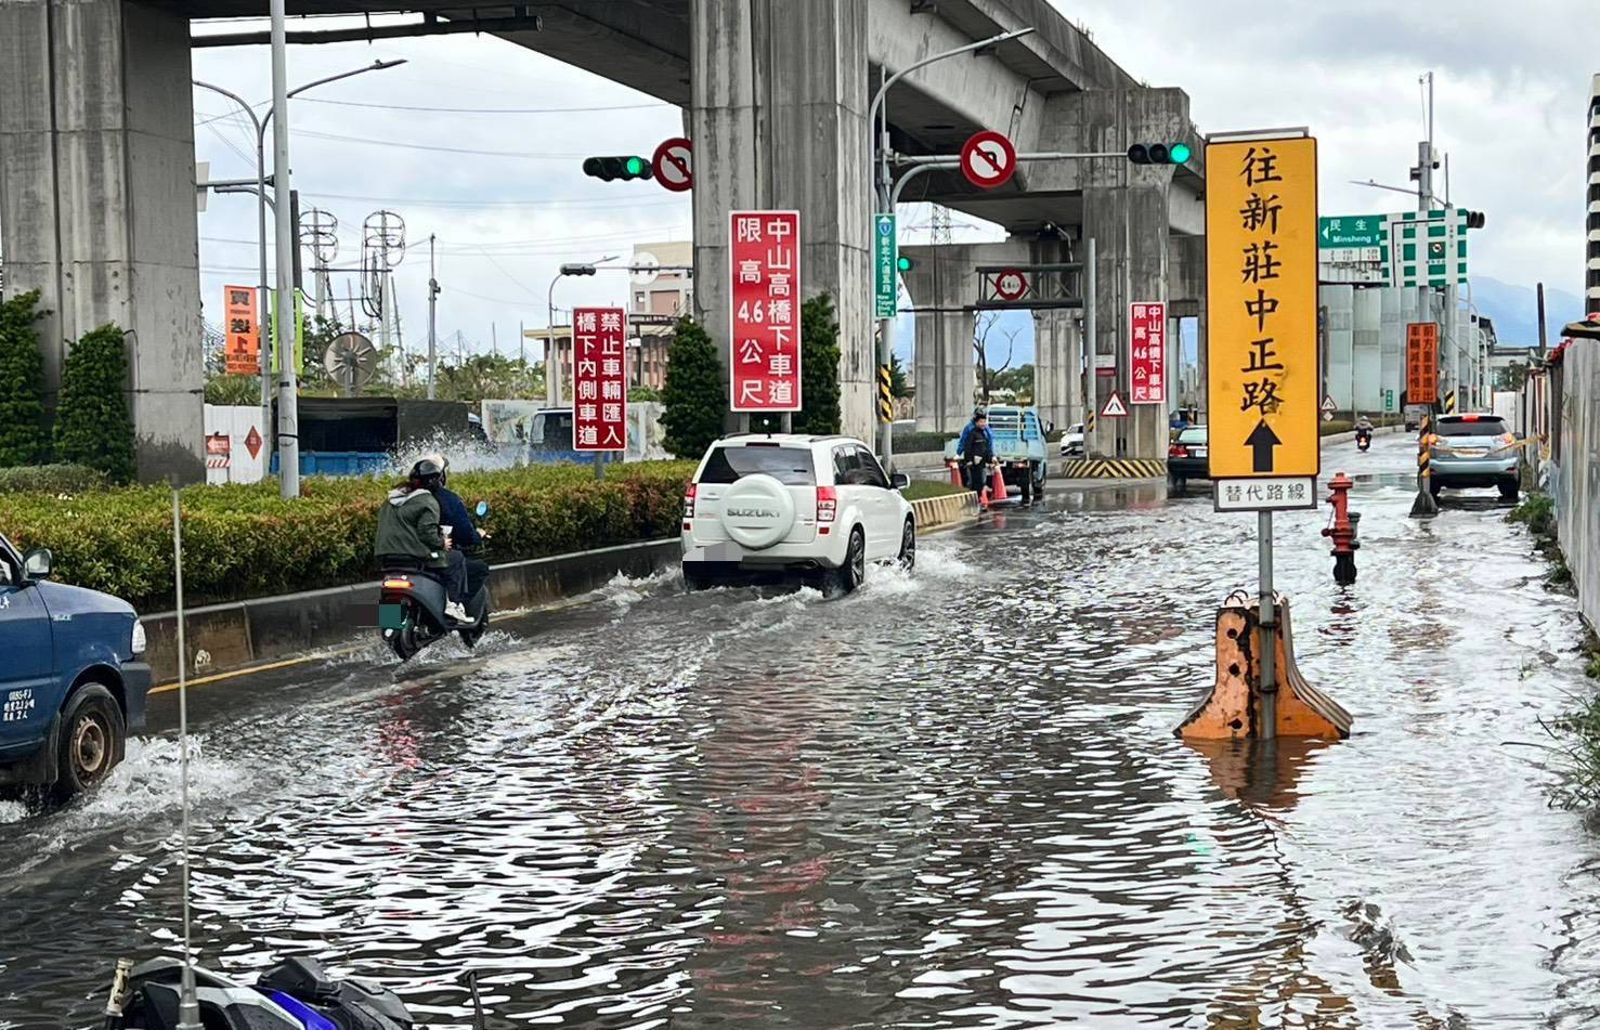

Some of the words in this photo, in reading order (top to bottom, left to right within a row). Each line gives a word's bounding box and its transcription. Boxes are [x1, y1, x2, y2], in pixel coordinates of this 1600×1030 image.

[1239, 147, 1285, 416] 往新莊中正路
[1333, 234, 1372, 244] Minsheng
[737, 217, 763, 405] 限高4.6公尺
[767, 217, 793, 405] 中山高橋下車道
[1133, 305, 1147, 400] 限高4.6公尺
[1148, 305, 1161, 400] 中山高橋下車道
[577, 312, 598, 445] 橋下內側車道
[600, 312, 622, 445] 禁止車輛匯入
[727, 508, 780, 518] SUZUKI
[1225, 482, 1306, 502] 替代路線
